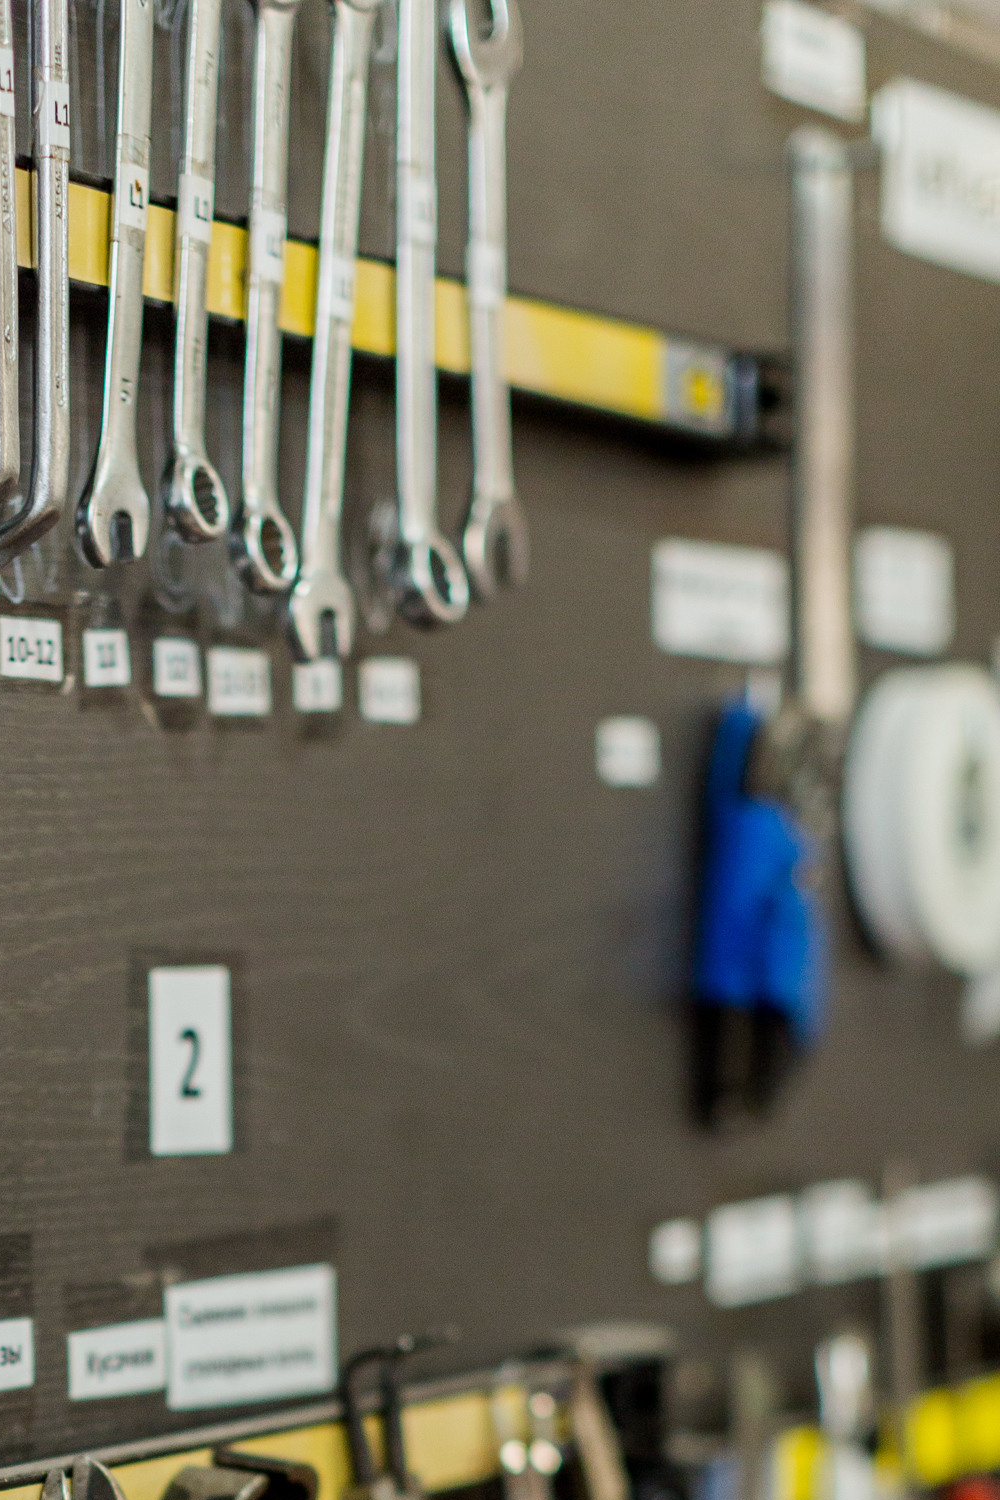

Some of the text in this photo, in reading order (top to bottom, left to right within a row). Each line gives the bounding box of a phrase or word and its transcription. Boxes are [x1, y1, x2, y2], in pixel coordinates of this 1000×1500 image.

[54, 100, 70, 127] L1
[7, 635, 56, 666] 10-12
[180, 1028, 202, 1098] 2
